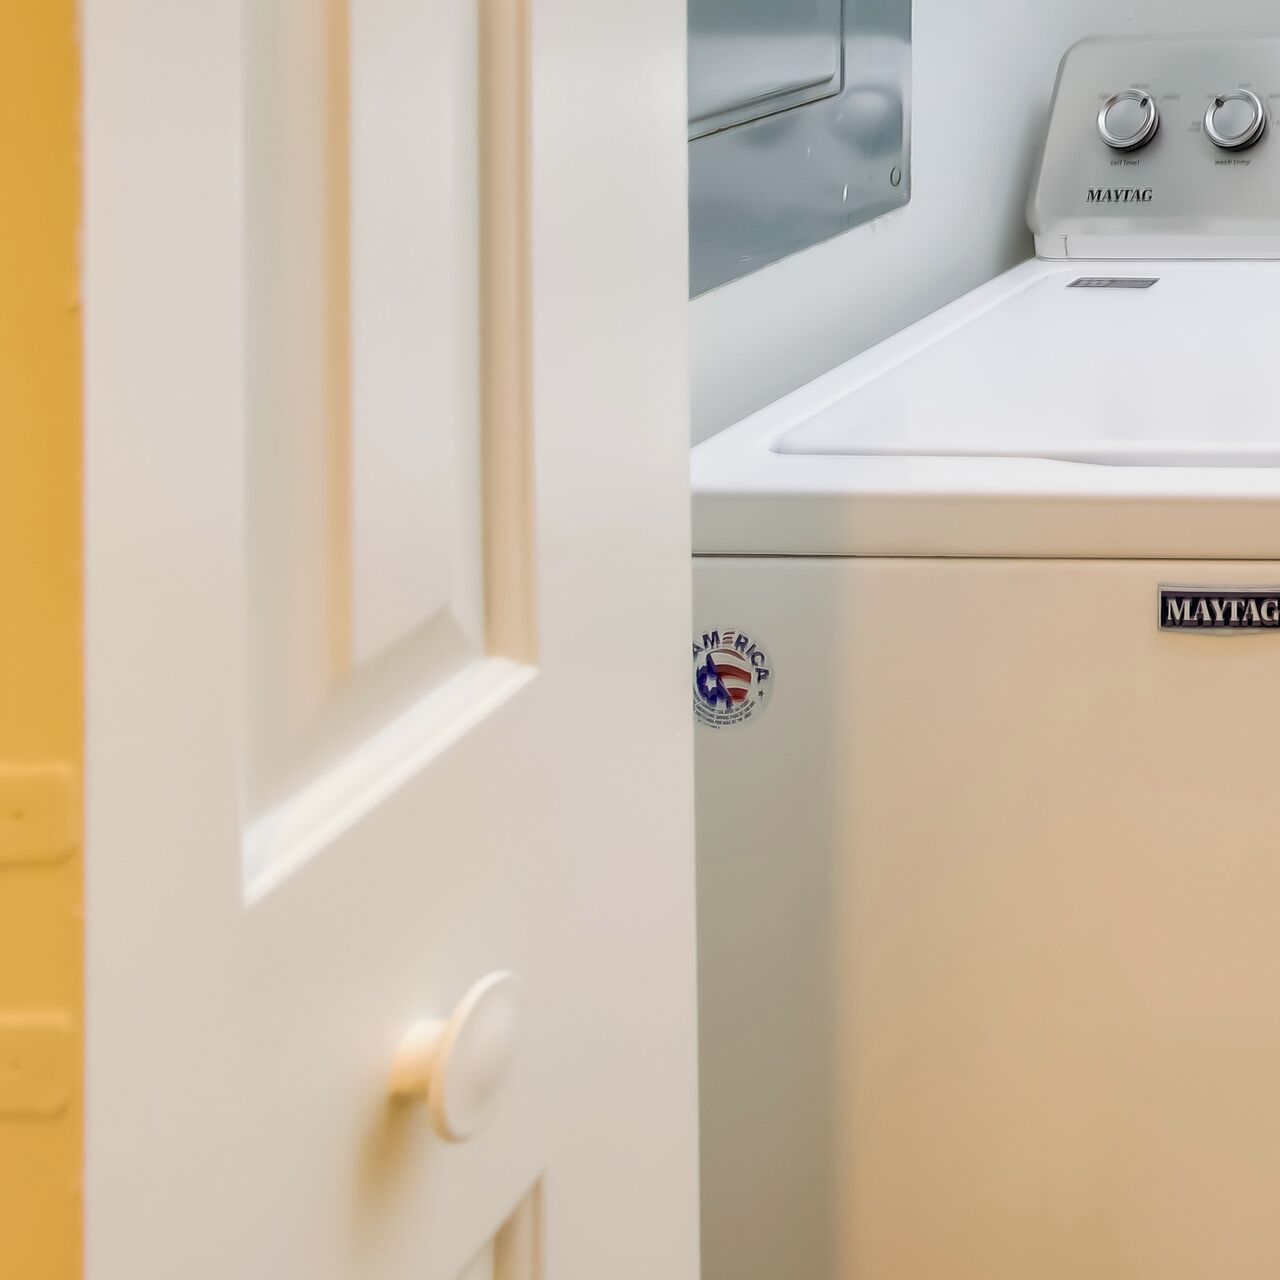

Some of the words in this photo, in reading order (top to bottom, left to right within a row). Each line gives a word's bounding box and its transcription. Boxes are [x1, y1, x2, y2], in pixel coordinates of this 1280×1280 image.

[1086, 188, 1153, 203] MAYTAG
[1166, 598, 1280, 622] MAYTAG
[693, 630, 770, 684] AMERICA
